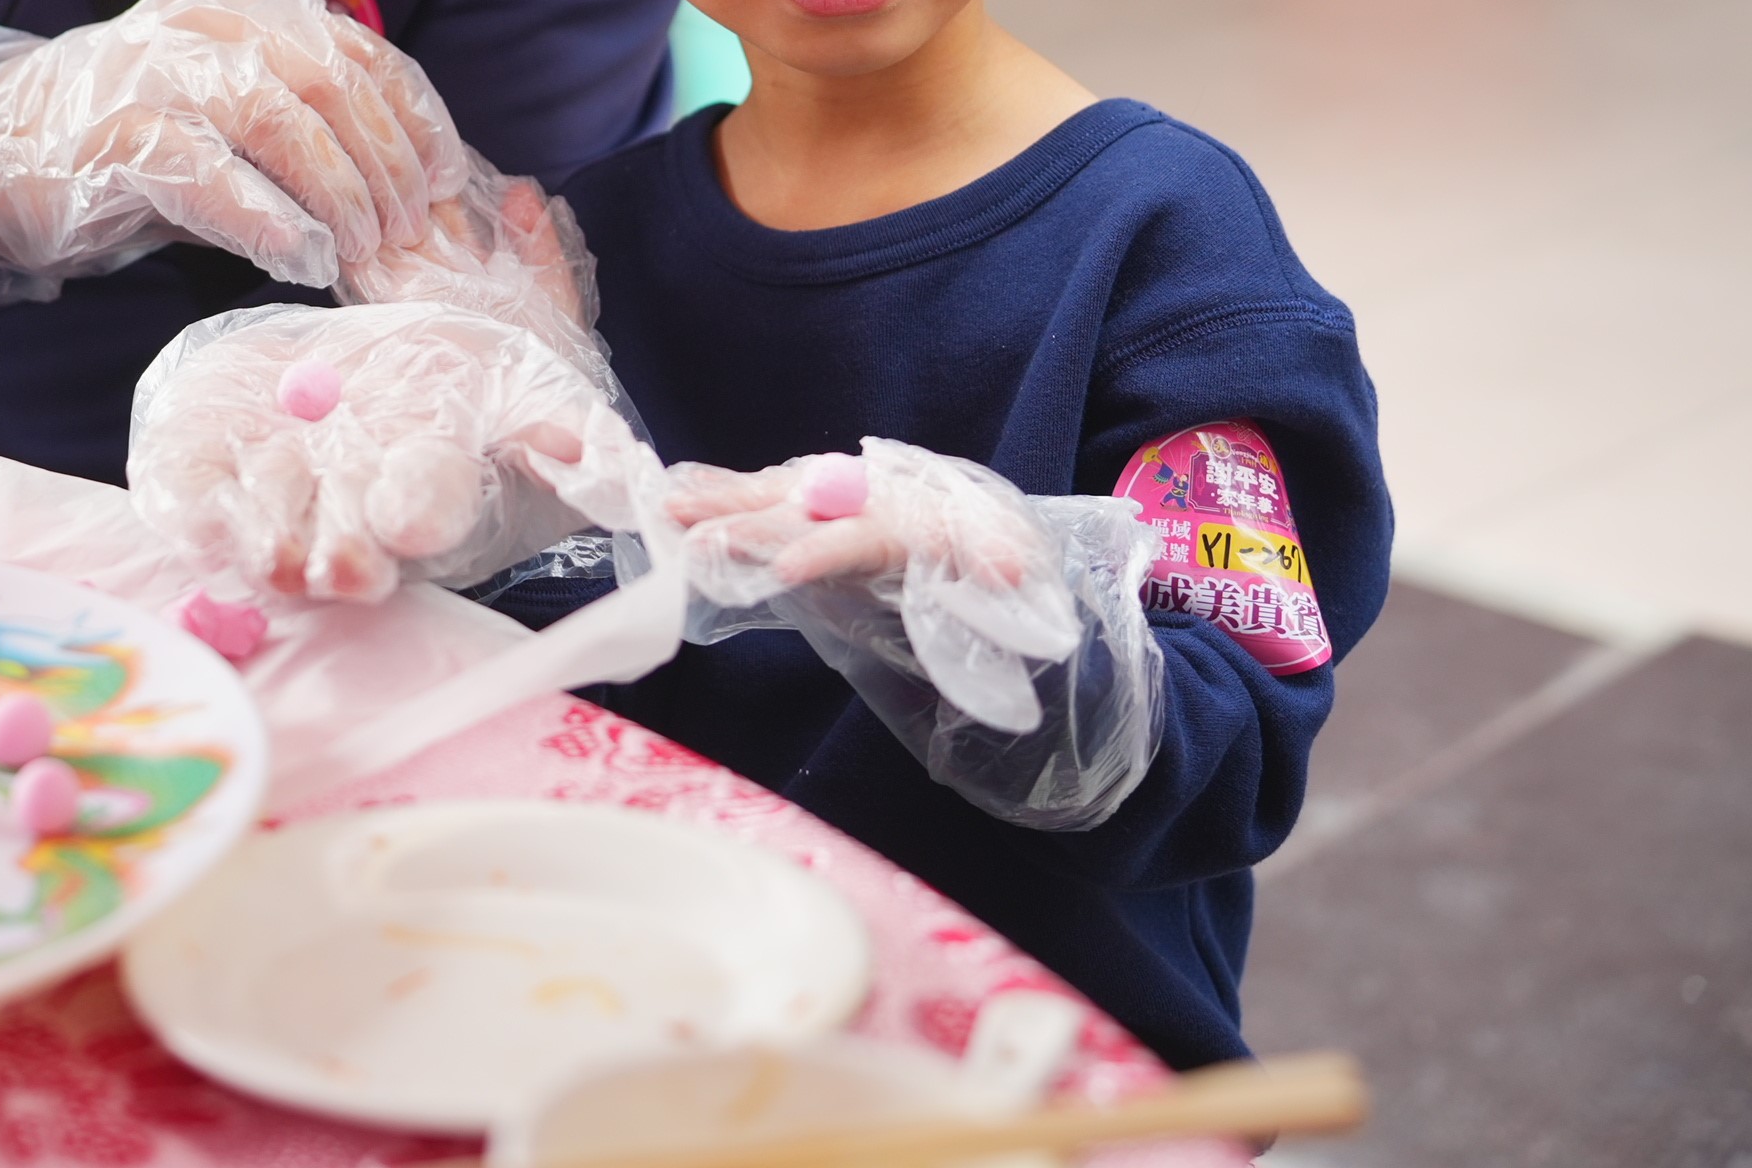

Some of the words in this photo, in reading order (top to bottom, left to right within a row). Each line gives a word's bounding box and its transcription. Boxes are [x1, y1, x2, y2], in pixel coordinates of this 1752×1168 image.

[1205, 460, 1279, 500] 謝平安
[1151, 517, 1191, 540] 區域
[1223, 507, 1270, 523] Thanksgiving
[1148, 573, 1327, 645] 成美貴賓
